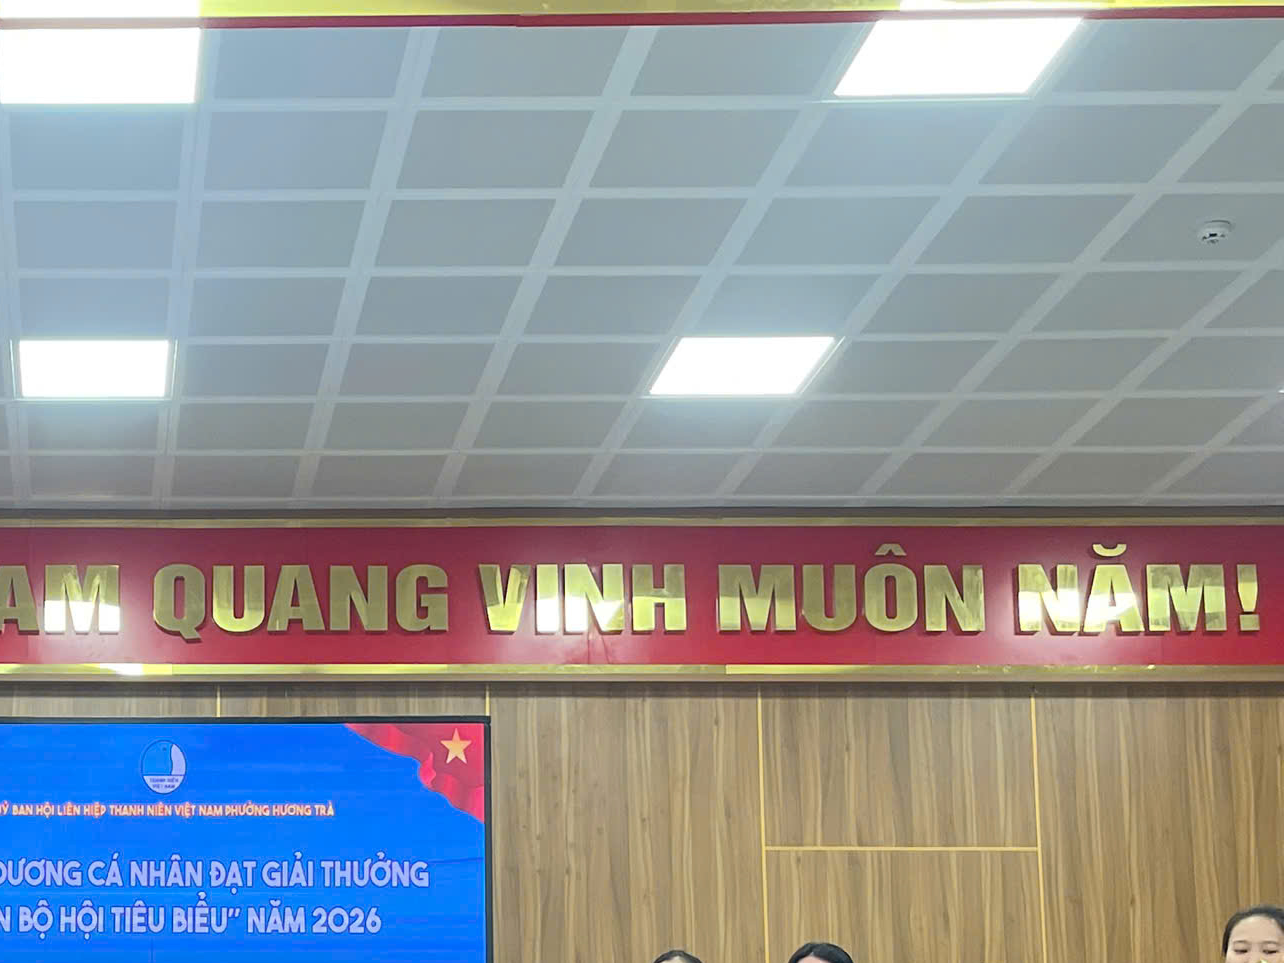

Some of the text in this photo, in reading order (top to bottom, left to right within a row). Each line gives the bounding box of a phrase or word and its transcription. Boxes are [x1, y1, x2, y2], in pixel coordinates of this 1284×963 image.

[153, 564, 449, 641] QUANG
[478, 563, 687, 633] VINH
[718, 543, 986, 632] MUÔN
[1017, 543, 1260, 633] NĂM!
[12, 804, 33, 816] BAN
[35, 801, 55, 818] HỘI
[57, 801, 81, 816] LIÊN
[83, 801, 107, 818] HIỆP
[109, 804, 145, 817] THANH
[147, 801, 172, 817] NIÊN
[175, 801, 196, 818] VIỆT
[198, 804, 222, 816] NAM
[272, 802, 311, 817] HƯƠNG
[315, 800, 335, 817] TRÀ
[87, 851, 124, 887] CÁ
[130, 853, 203, 887] NHÂN
[209, 860, 257, 895] ĐẠT
[261, 851, 314, 888] GIẢI
[320, 851, 430, 888] THƯỞNG
[18, 899, 54, 940] BỘ
[59, 899, 105, 940] HỘI
[110, 899, 165, 934] TIÊU
[247, 899, 306, 934] NĂM
[312, 906, 382, 934] 2026
